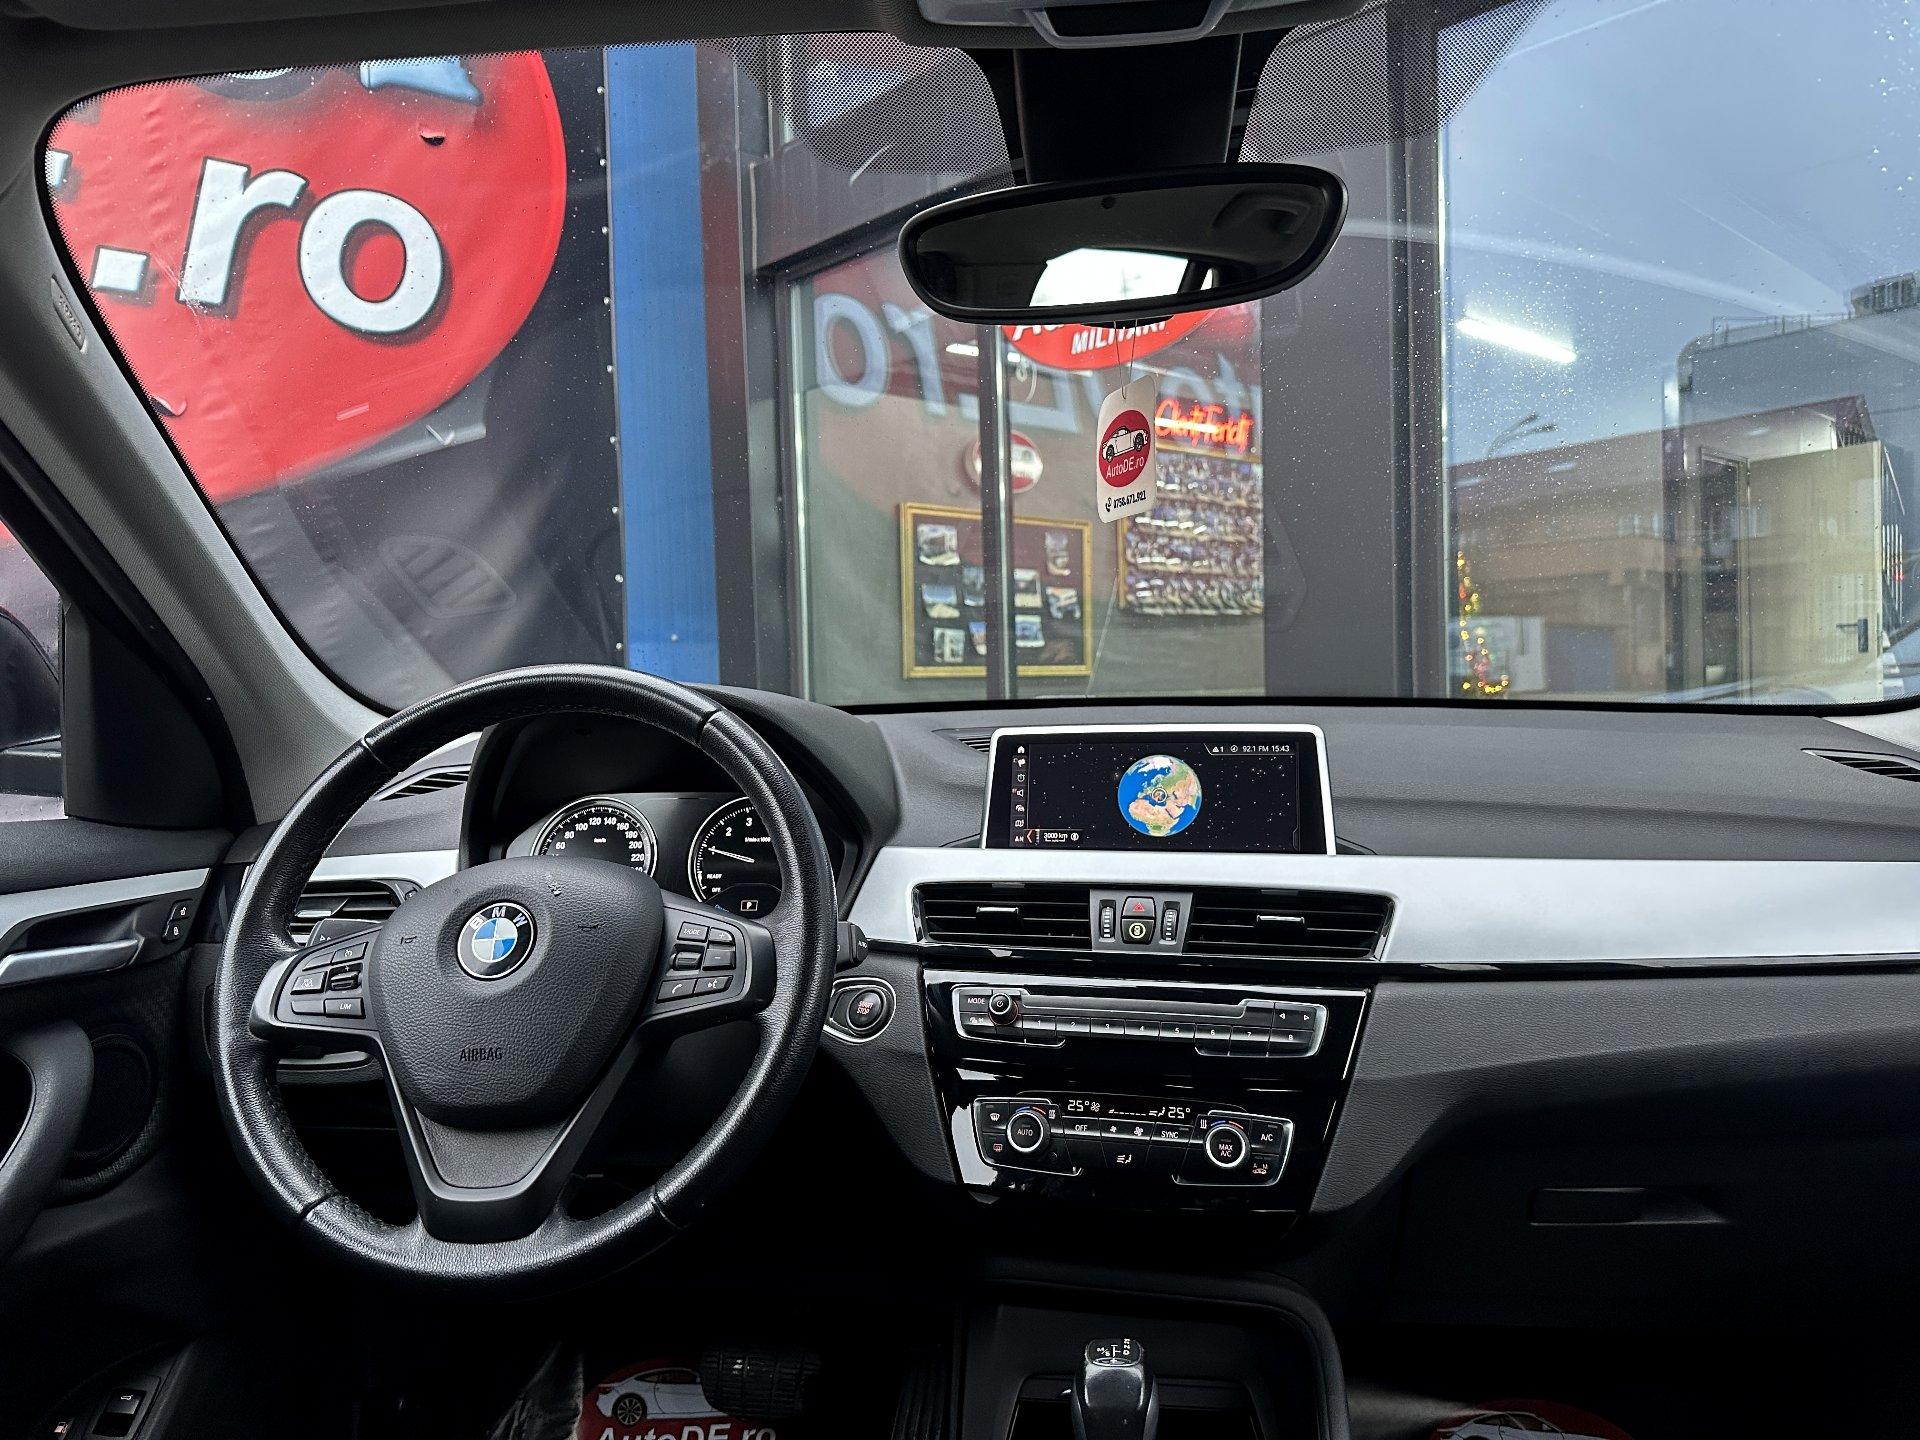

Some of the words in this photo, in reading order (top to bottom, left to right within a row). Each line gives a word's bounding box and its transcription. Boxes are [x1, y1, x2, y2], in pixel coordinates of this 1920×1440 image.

[46, 149, 443, 335] .ro
[1106, 456, 1145, 479] AutoDE.ro
[1271, 745, 1290, 753] 15:43
[589, 817, 602, 826] 120
[603, 817, 617, 825] 140
[745, 817, 753, 827] 3
[575, 823, 589, 831] 100
[616, 823, 630, 831] 160
[564, 831, 575, 839] 80
[624, 831, 638, 839] 180
[725, 827, 732, 837] 2
[555, 842, 566, 850] 60
[628, 841, 643, 849] 200
[746, 901, 752, 910] P
[469, 906, 528, 931] BMW
[683, 928, 701, 936] MODE
[858, 1000, 874, 1009] START
[967, 997, 986, 1005] MODE
[856, 1006, 870, 1015] STOP
[459, 1048, 503, 1062] AIRBAG
[1067, 1099, 1090, 1112] 25°
[1167, 1107, 1191, 1119] 25°
[1074, 1124, 1088, 1132] OFF
[1016, 1129, 1034, 1137] AUTO
[1160, 1130, 1179, 1139] SYNC
[1260, 1133, 1274, 1142] A/C
[597, 1423, 777, 1440] AtoDEro
